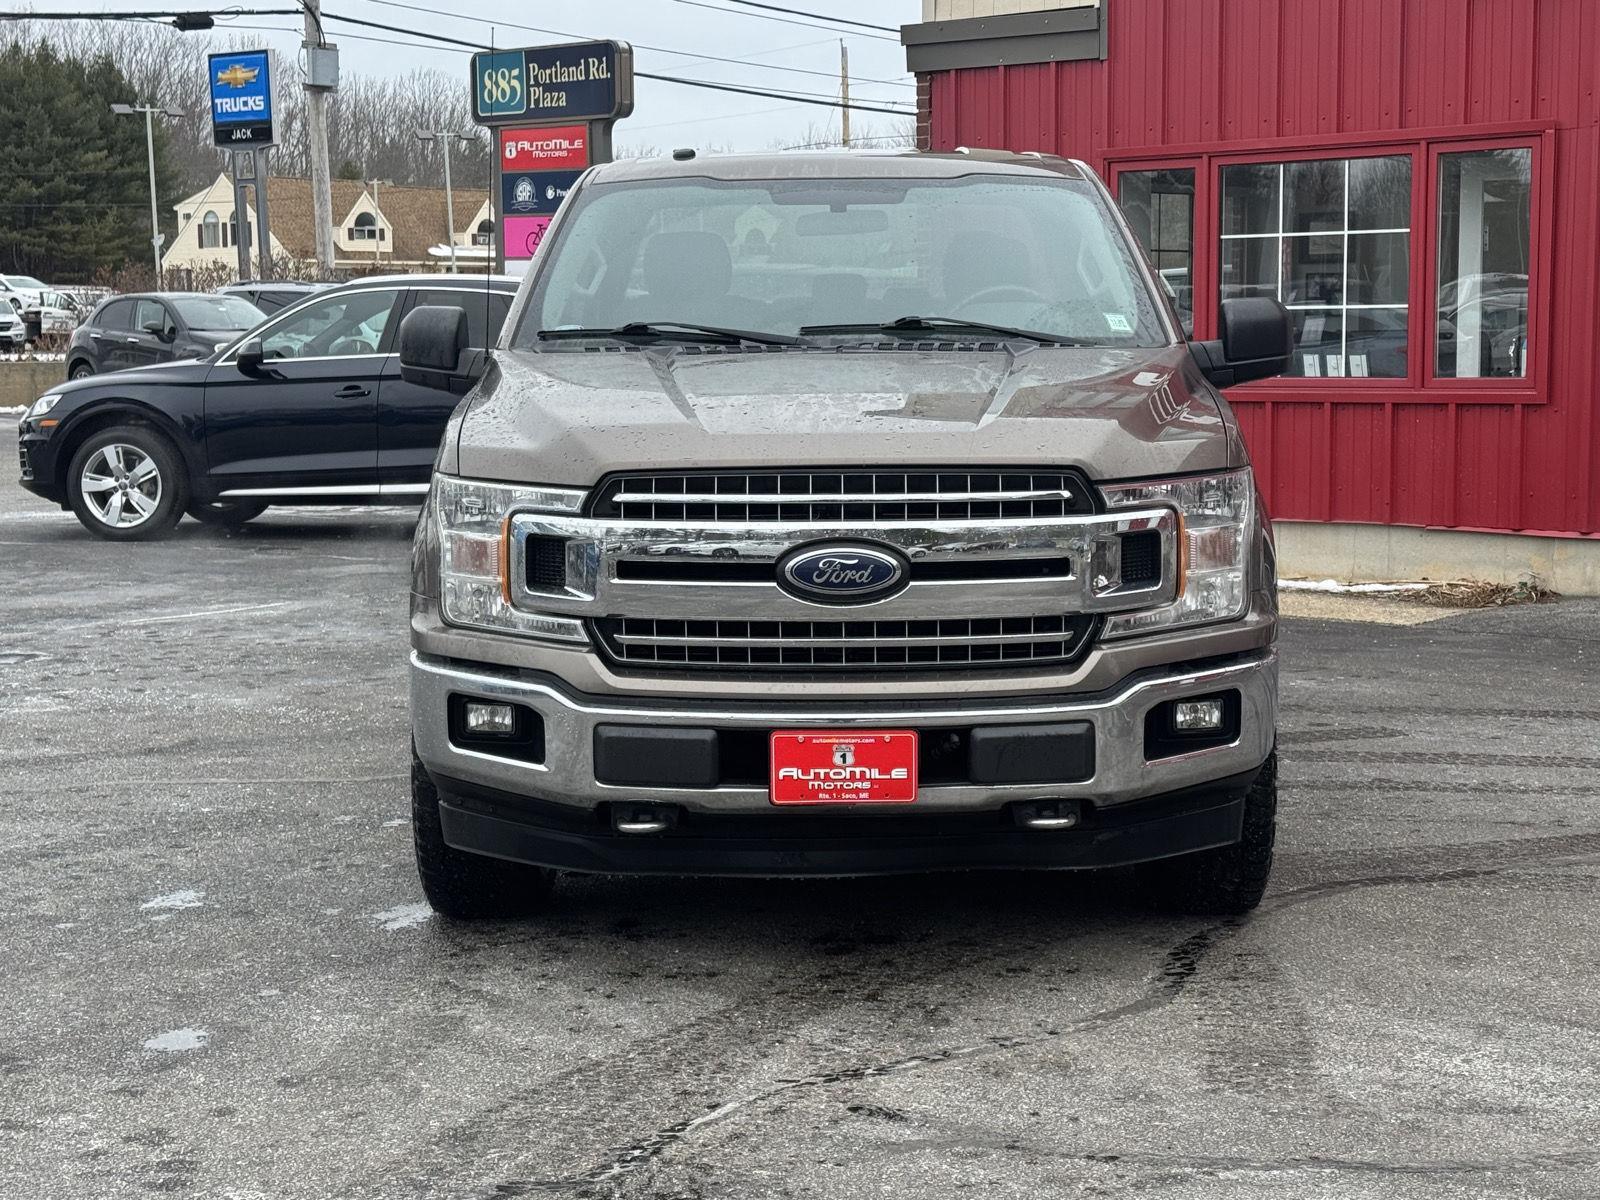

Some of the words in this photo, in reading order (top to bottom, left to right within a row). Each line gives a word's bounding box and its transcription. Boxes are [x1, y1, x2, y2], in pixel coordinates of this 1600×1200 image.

[528, 59, 585, 85] Portland
[588, 56, 611, 80] Rd.
[484, 67, 521, 106] 885
[214, 95, 264, 113] TRUCKS
[530, 86, 567, 109] Plaza
[231, 128, 252, 140] JACK
[517, 139, 583, 151] AUTOMILE
[812, 558, 874, 584] Ford
[840, 753, 846, 764] 1
[778, 767, 908, 780] AUTOMILE
[808, 781, 872, 790] MOTORS
